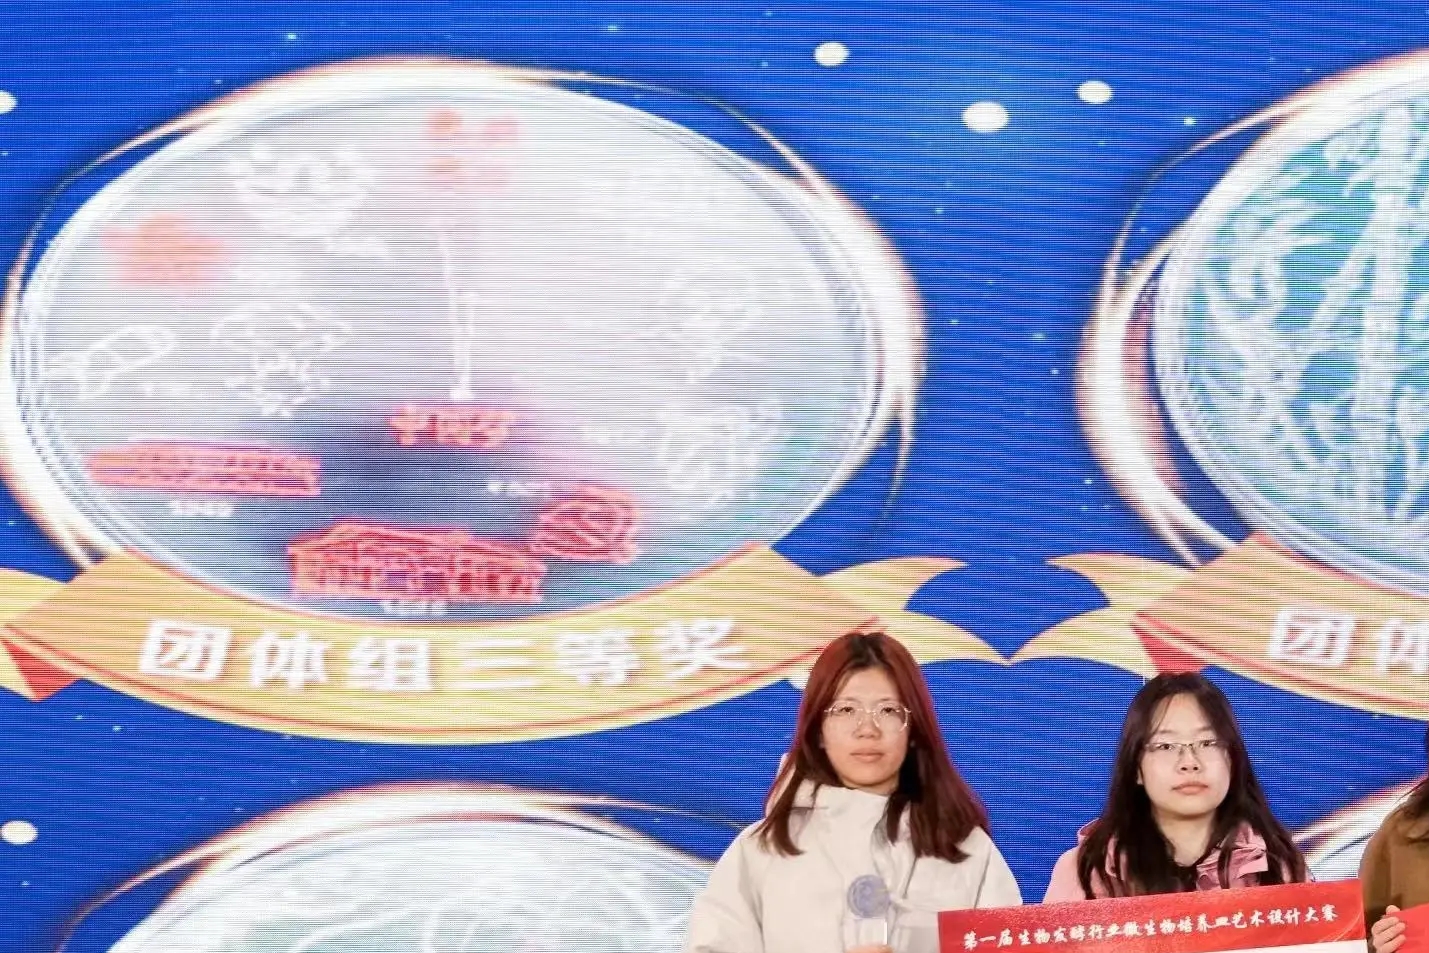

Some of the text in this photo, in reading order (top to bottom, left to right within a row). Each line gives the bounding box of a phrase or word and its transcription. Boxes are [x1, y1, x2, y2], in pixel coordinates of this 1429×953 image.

[139, 616, 752, 692] 团体组三等奖
